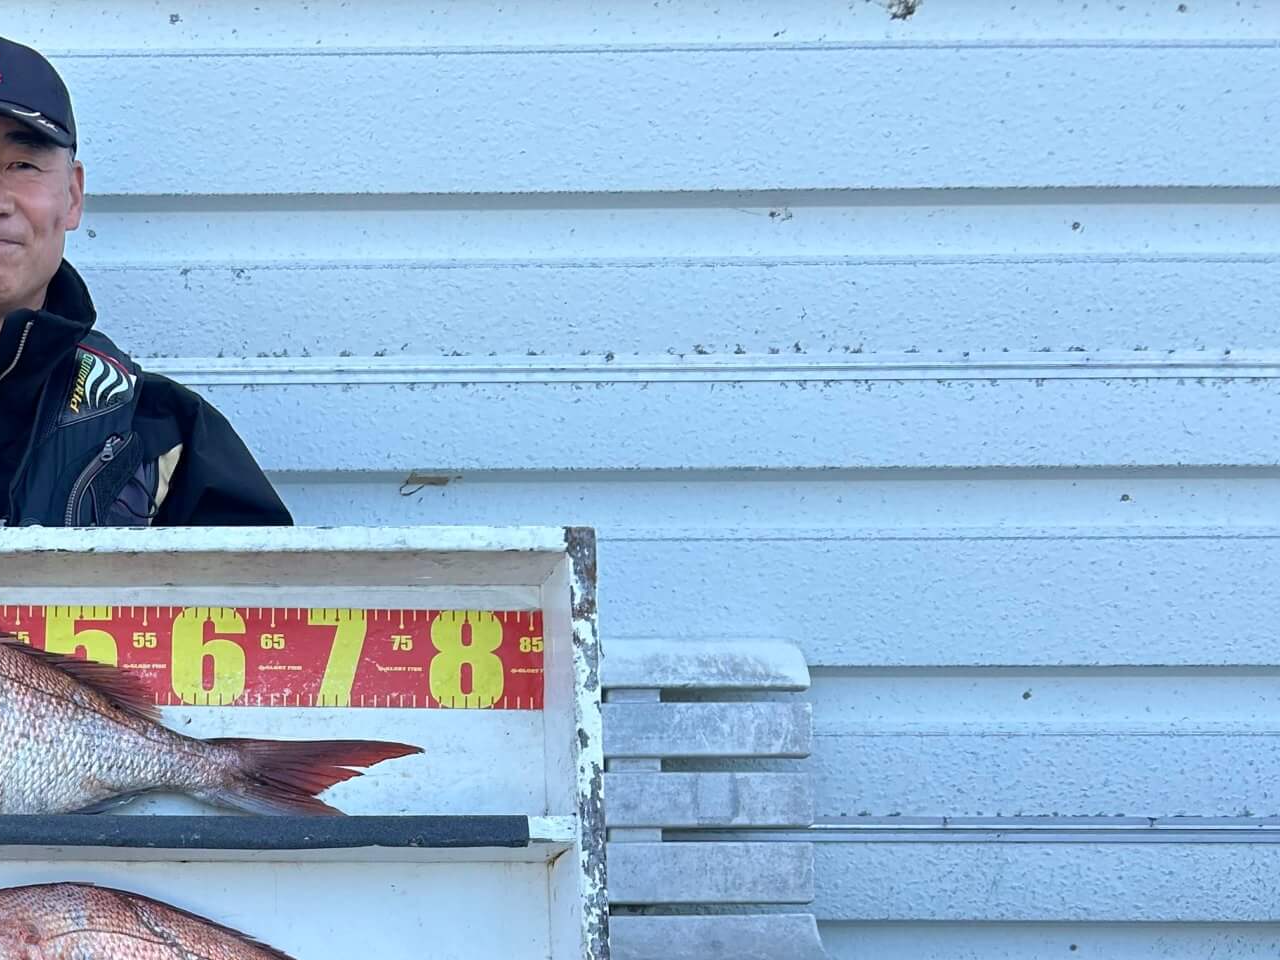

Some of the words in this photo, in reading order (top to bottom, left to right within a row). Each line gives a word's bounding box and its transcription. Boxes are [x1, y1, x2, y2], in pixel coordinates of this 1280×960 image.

[132, 632, 158, 649] 55
[260, 633, 285, 650] 65
[391, 635, 414, 651] 75
[519, 636, 544, 653] 85
[171, 606, 246, 705] 6
[307, 607, 368, 706] 7
[429, 609, 504, 709] 8
